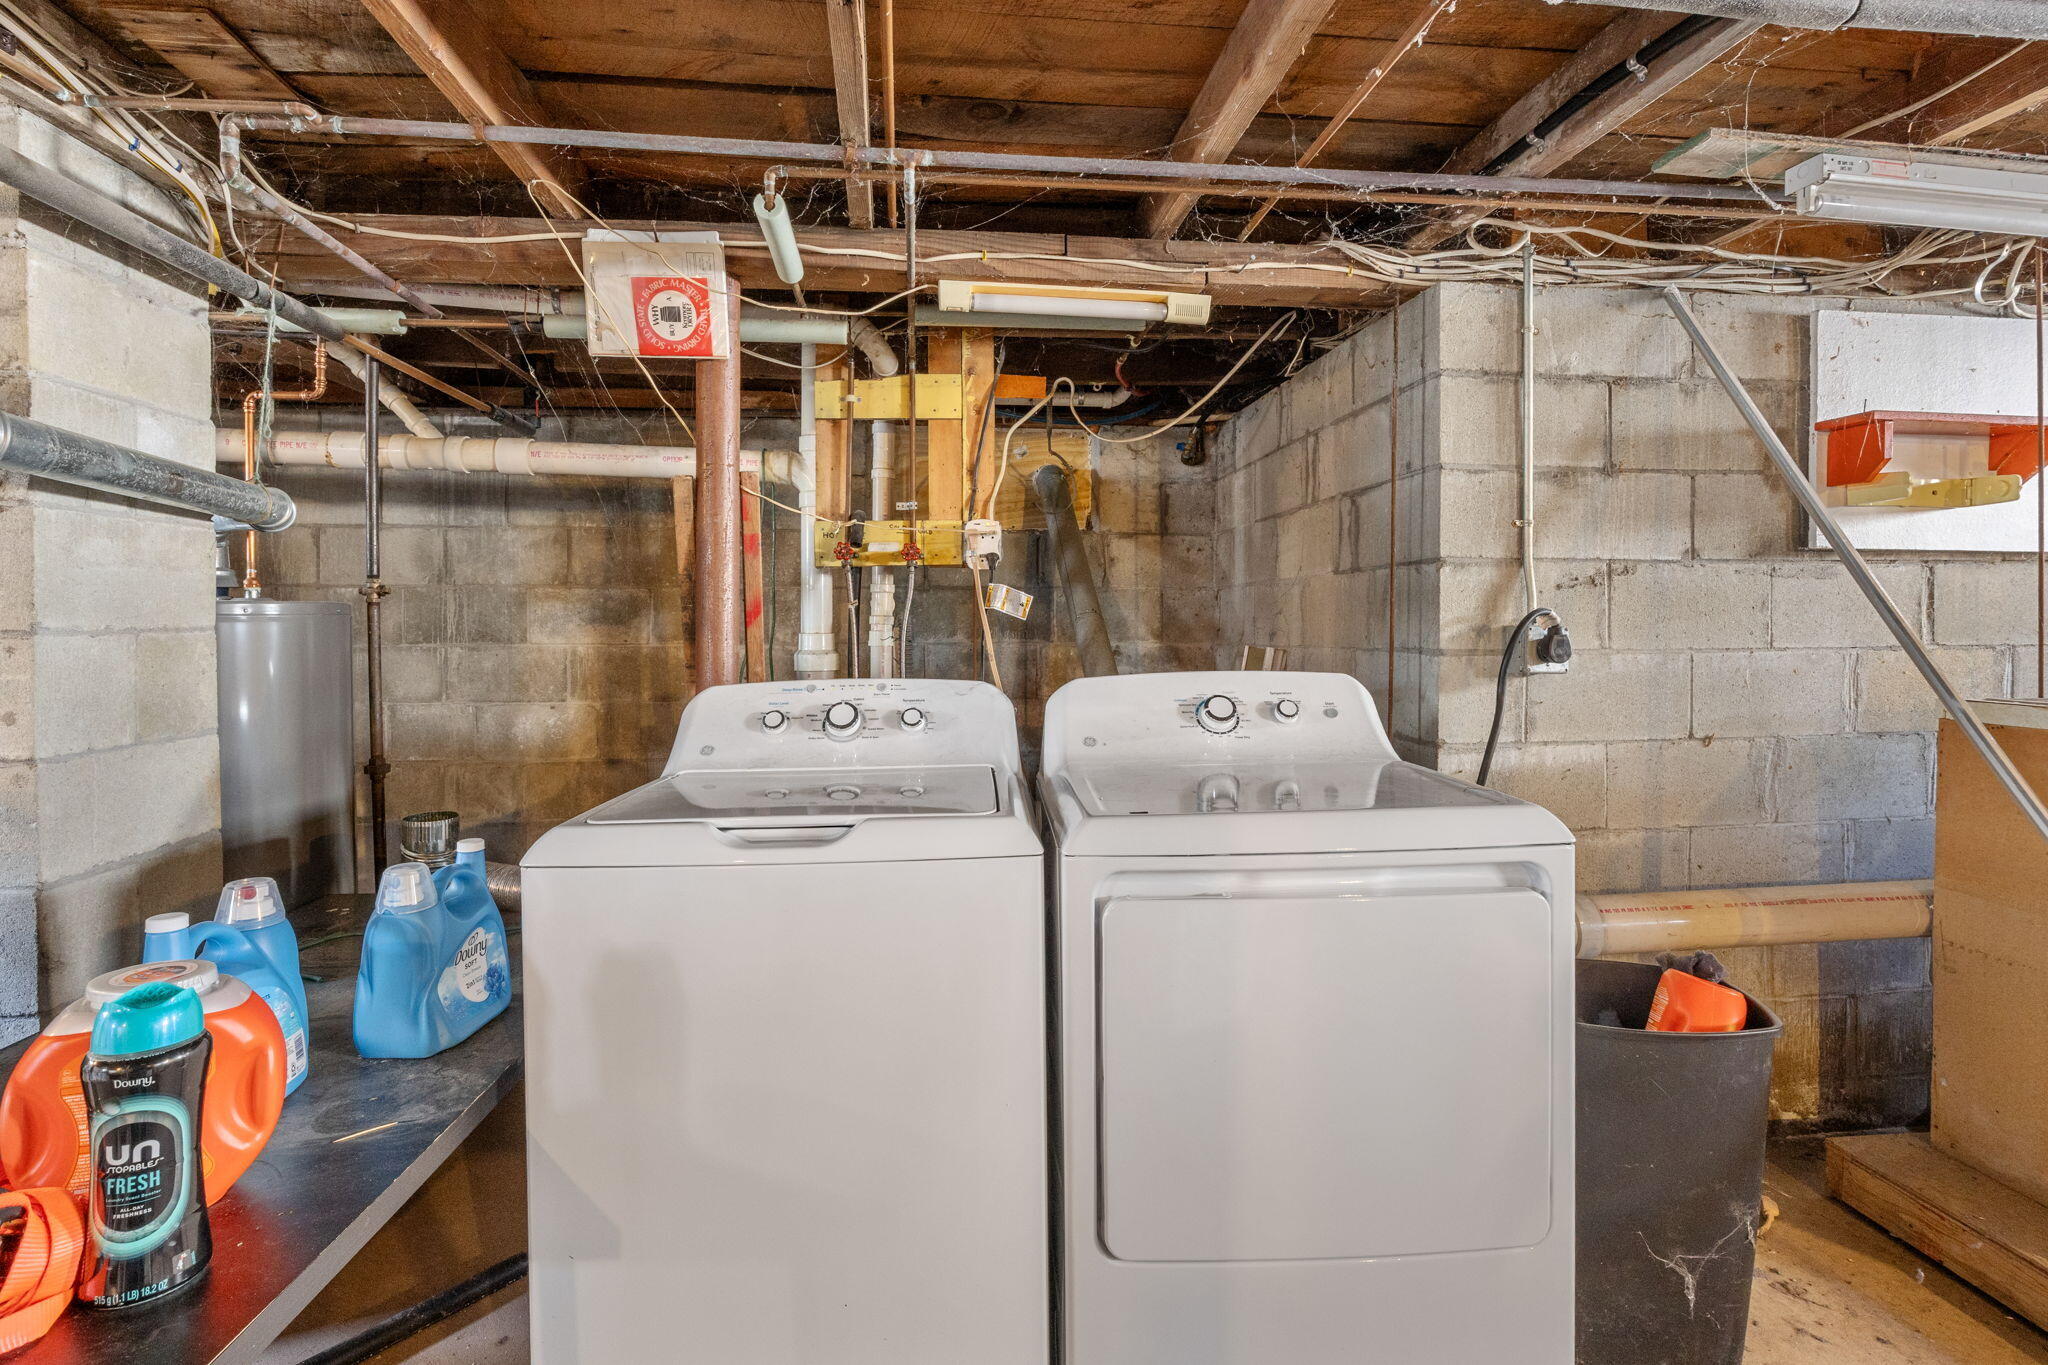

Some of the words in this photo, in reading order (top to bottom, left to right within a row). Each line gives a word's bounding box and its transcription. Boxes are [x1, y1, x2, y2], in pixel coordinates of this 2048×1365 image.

[642, 279, 667, 298] FABRIC
[670, 279, 702, 302] MASTER
[637, 304, 646, 327] STATE
[651, 304, 660, 326] WHY
[643, 328, 666, 349] SOLID
[673, 335, 701, 353] DRYING
[279, 441, 294, 449] PIPE
[454, 939, 488, 966] Downy
[465, 958, 478, 969] SOFT
[113, 1076, 154, 1089] Downy
[106, 1170, 161, 1195] FRESH
[112, 1207, 153, 1220] FRESHNESS
[120, 1204, 145, 1213] ALL-DAY
[94, 1296, 106, 1305] 515
[127, 1289, 140, 1301] LB)
[141, 1283, 157, 1297] 18.2
[158, 1278, 169, 1290] OZ
